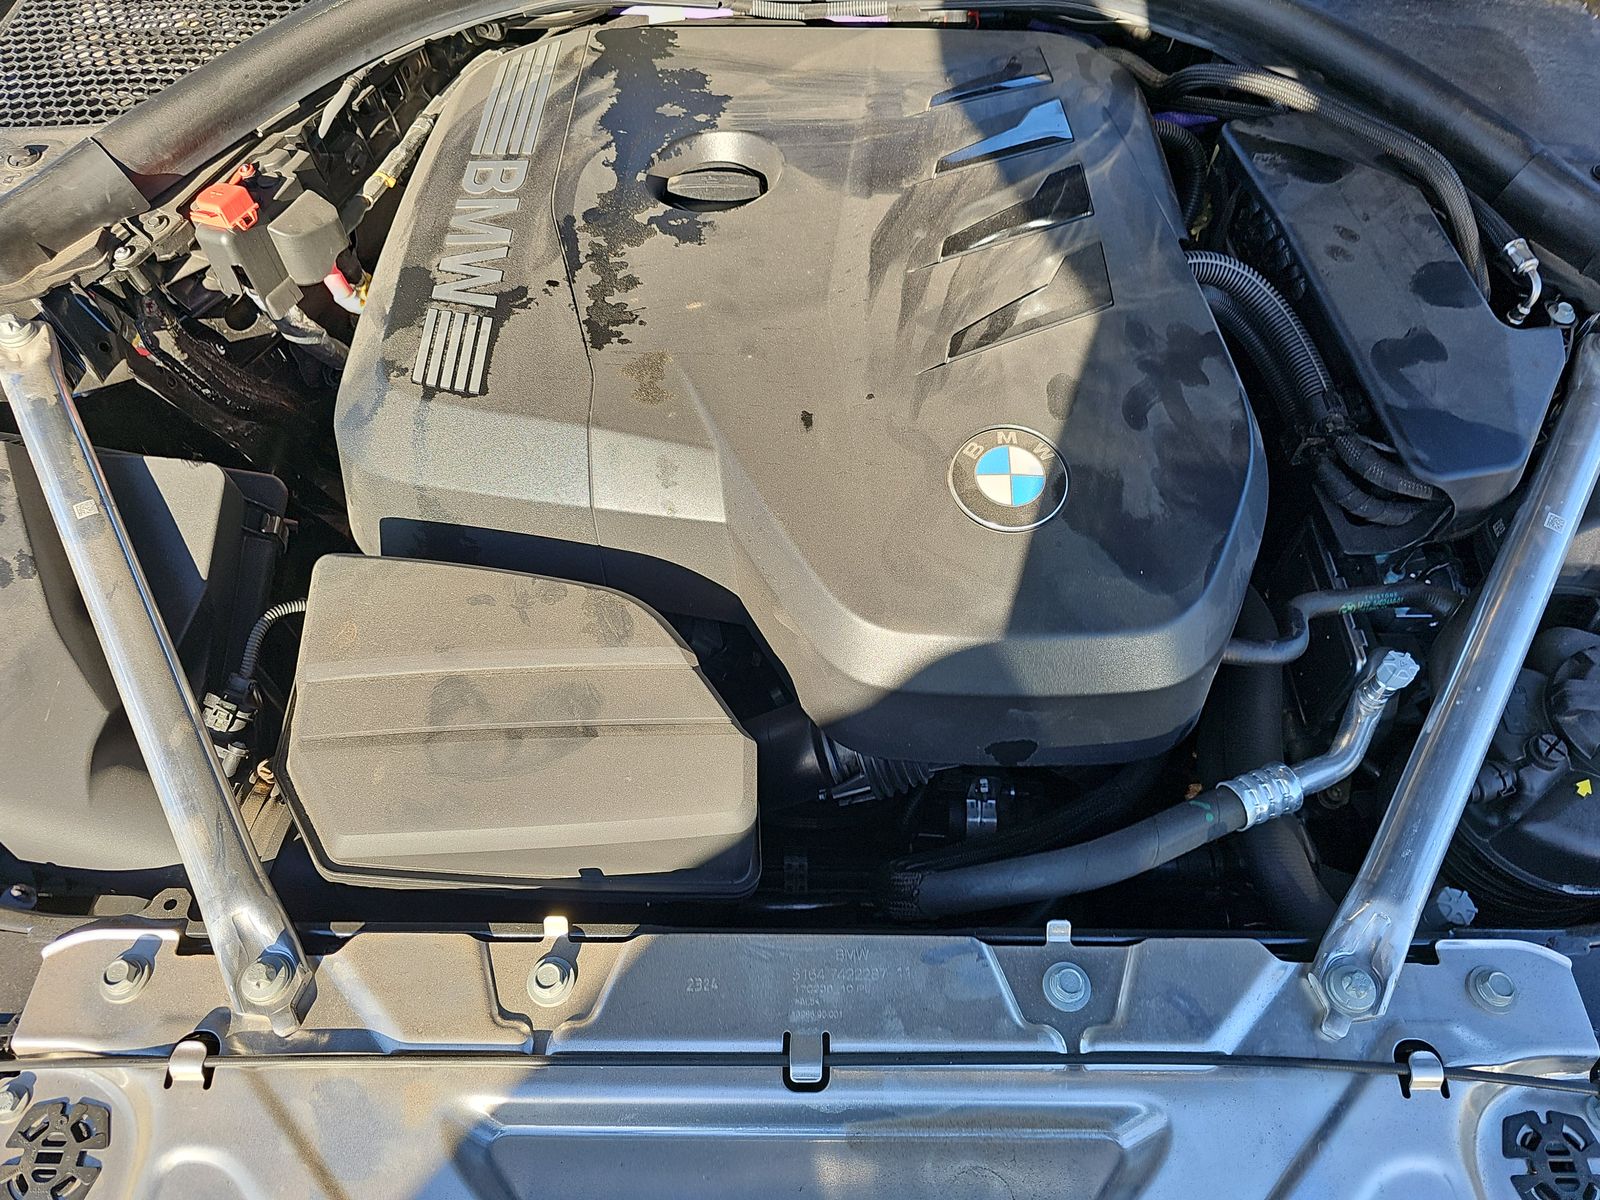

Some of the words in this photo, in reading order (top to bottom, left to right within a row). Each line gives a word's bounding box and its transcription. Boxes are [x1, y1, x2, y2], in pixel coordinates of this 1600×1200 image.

[431, 160, 530, 308] BMW
[962, 431, 1056, 460] BMW
[835, 948, 870, 961] BMW
[686, 977, 718, 992] 2324
